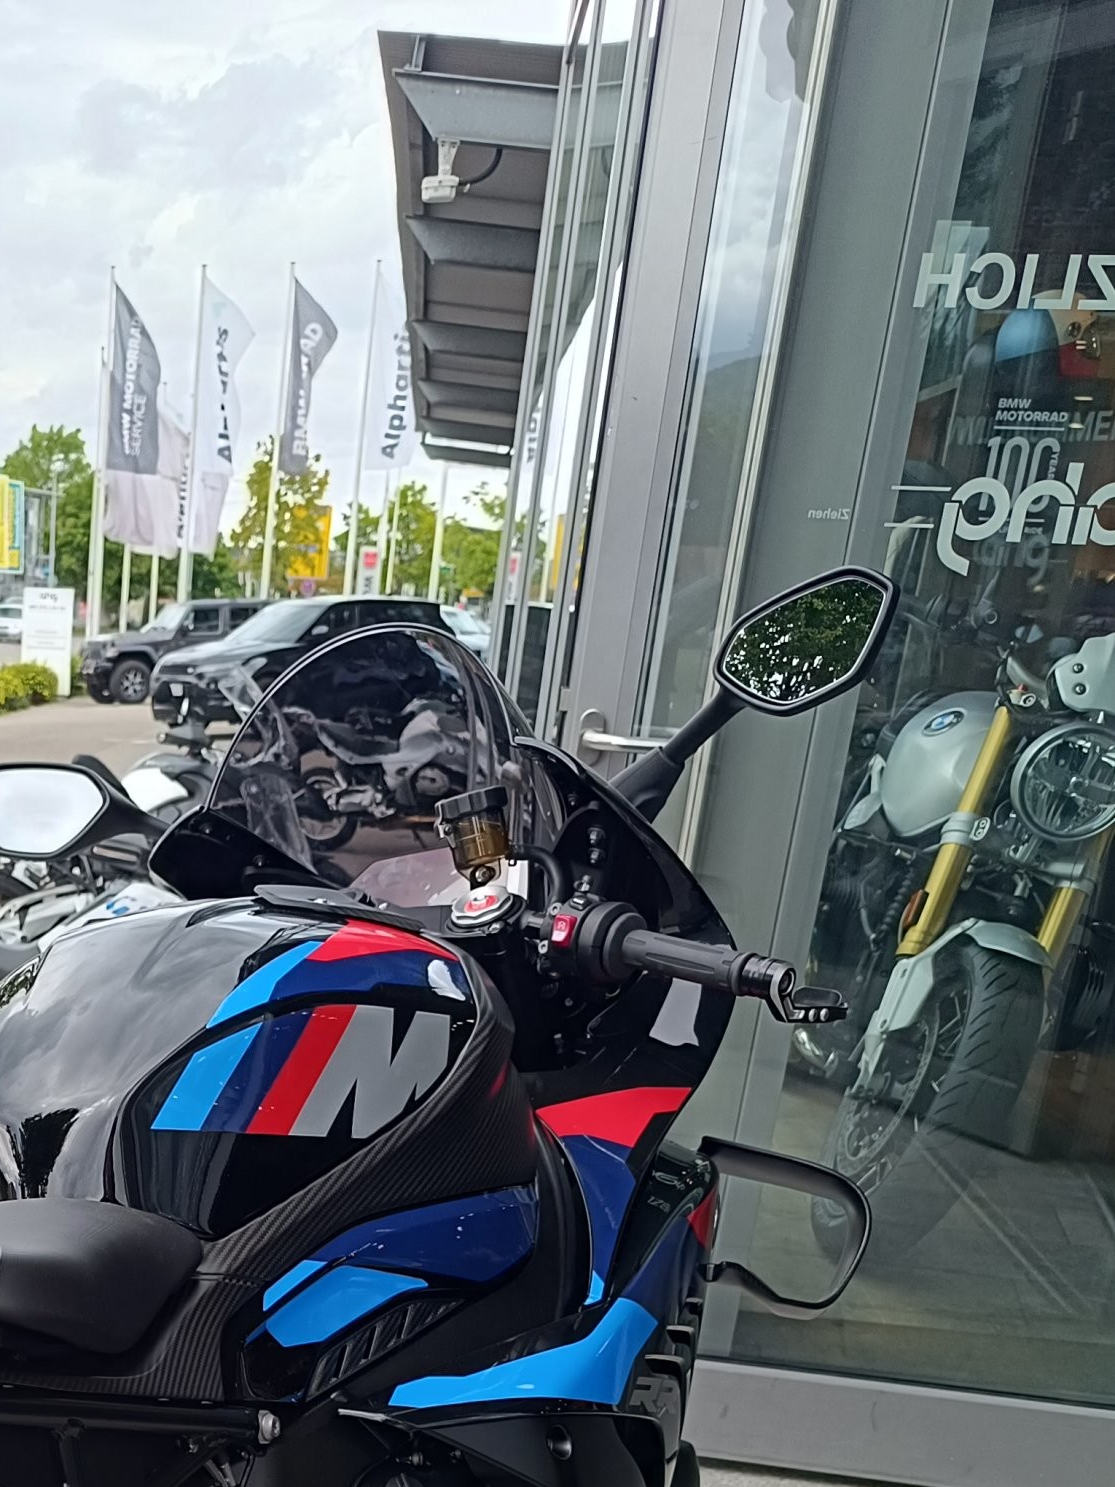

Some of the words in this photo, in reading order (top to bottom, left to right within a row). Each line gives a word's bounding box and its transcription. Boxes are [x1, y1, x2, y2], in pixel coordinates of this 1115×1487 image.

[998, 398, 1032, 409] BMW
[995, 410, 1068, 422] MOTORRAD
[130, 394, 148, 457] SERVICE
